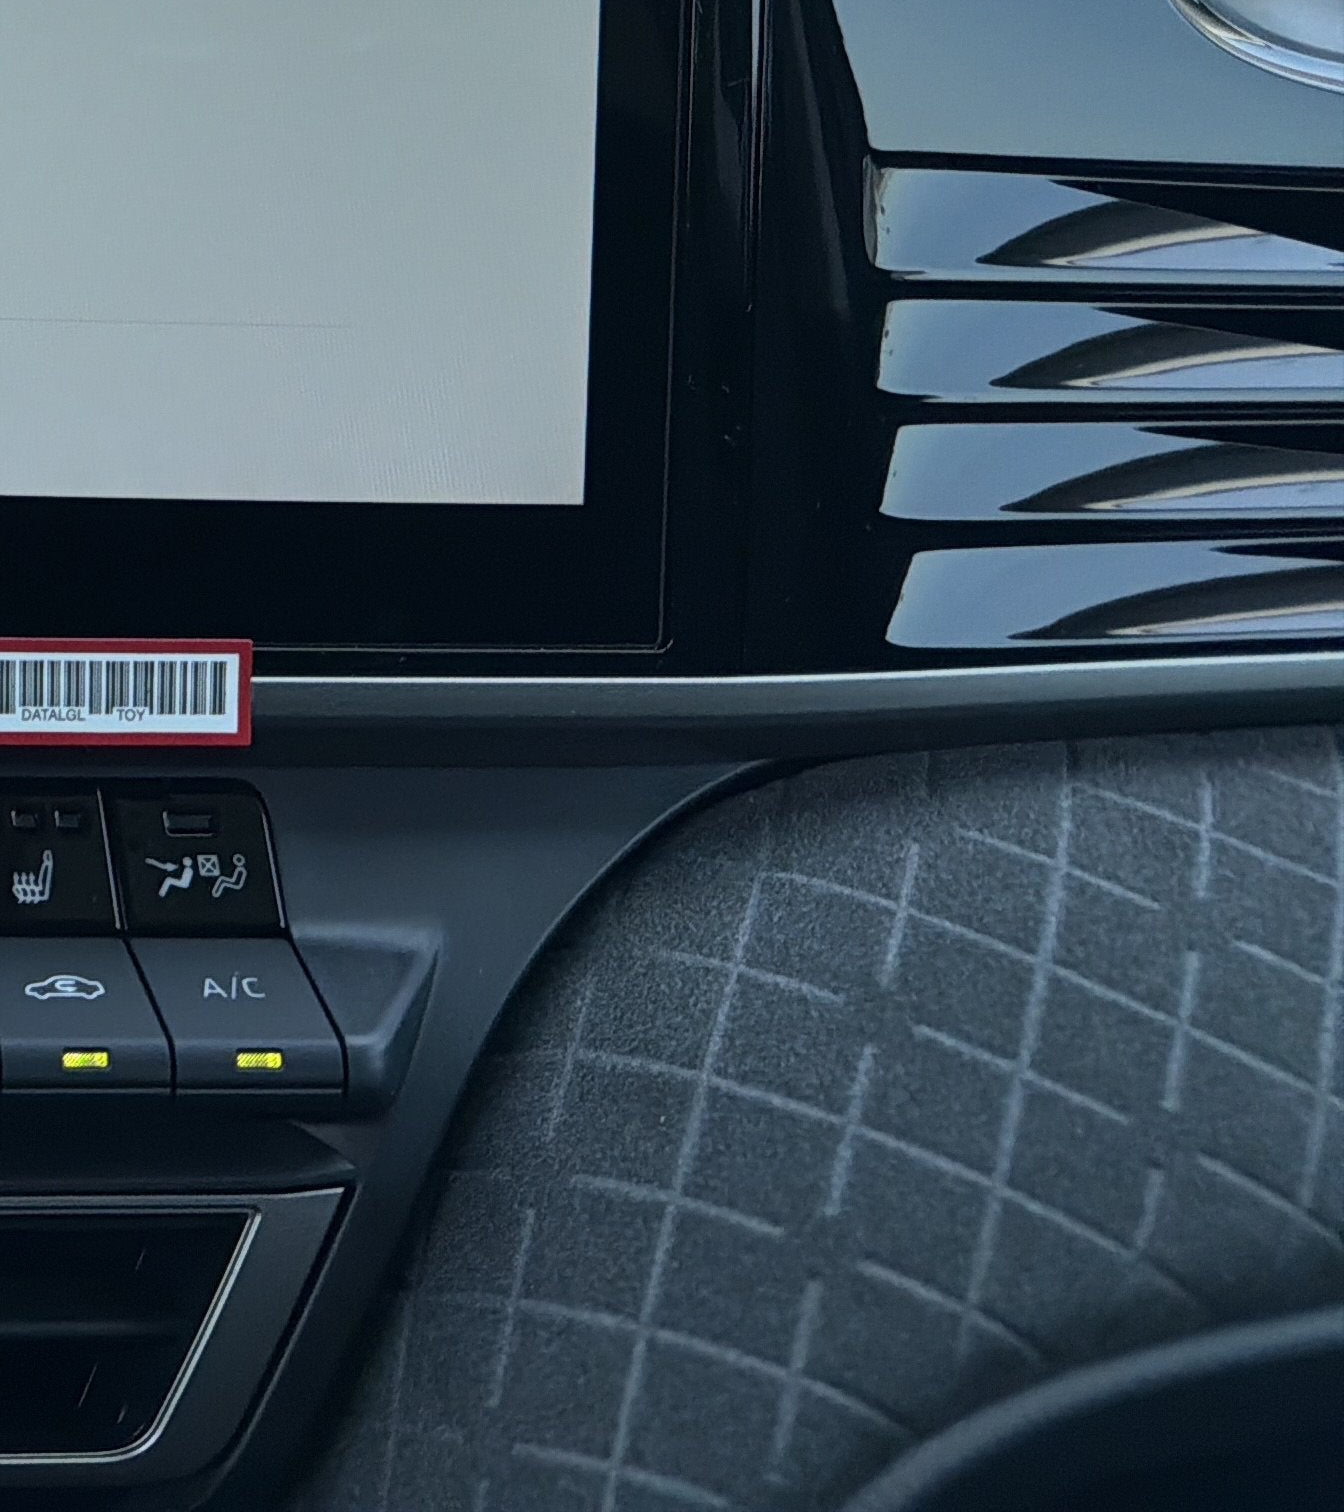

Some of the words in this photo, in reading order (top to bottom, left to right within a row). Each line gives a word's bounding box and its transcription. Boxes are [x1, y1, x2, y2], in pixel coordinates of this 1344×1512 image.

[21, 708, 85, 721] DATALGL
[116, 708, 145, 721] TOY
[202, 974, 266, 999] A/C
